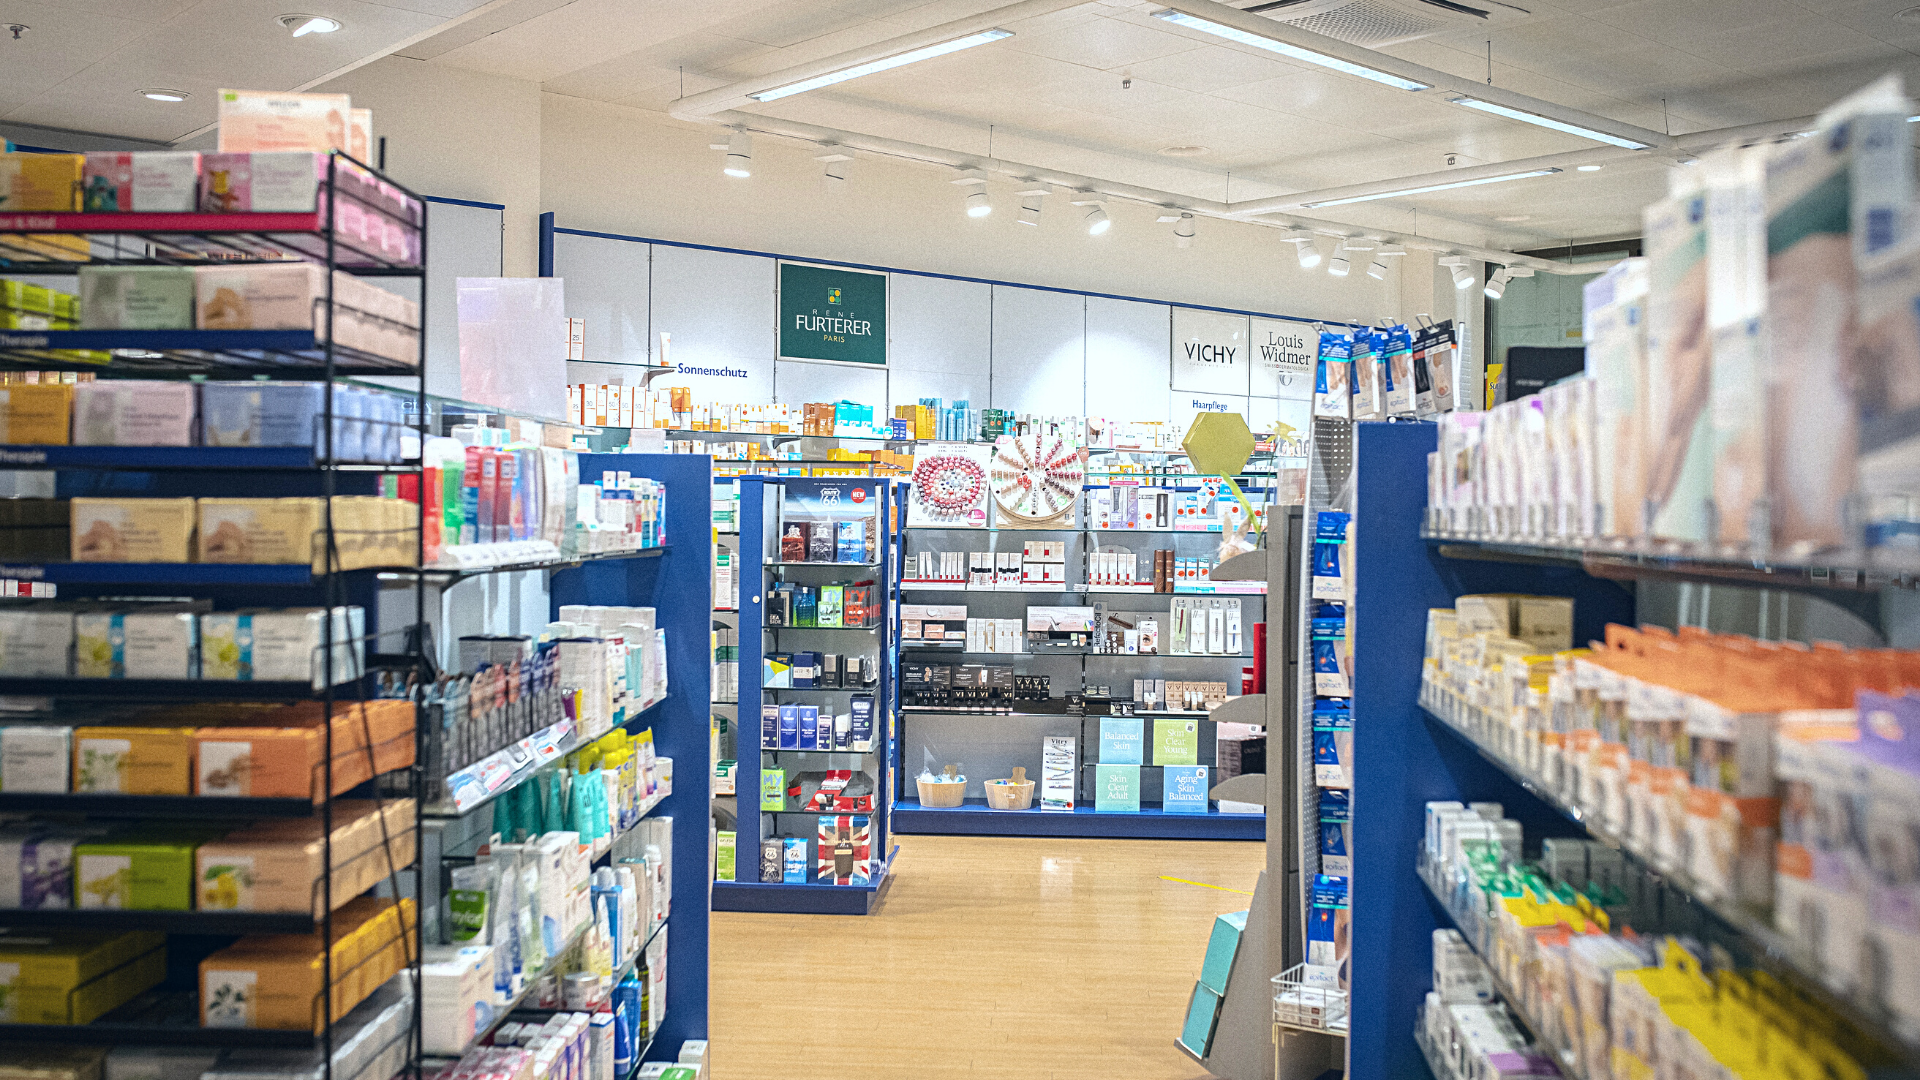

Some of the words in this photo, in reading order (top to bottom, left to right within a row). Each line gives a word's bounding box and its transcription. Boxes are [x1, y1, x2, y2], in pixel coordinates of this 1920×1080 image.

[812, 309, 854, 318] RENE
[796, 315, 871, 336] FURTERER
[823, 334, 845, 343] PARIS
[1268, 332, 1303, 349] Louis
[1184, 342, 1236, 364] VICHY
[1260, 345, 1311, 365] Widmer
[677, 362, 748, 378] Sonnenschutz
[1192, 399, 1228, 412] Haarpflege
[823, 496, 838, 506] 66
[1104, 732, 1139, 740] Balanced
[1167, 729, 1185, 737] Skin
[1113, 741, 1130, 750] Skin
[1165, 737, 1186, 746] Clear
[1163, 746, 1188, 755] Young
[763, 774, 783, 787] MY
[1109, 775, 1127, 783] Skin
[1174, 775, 1198, 784] Aging
[1107, 783, 1129, 791] Clear
[1177, 784, 1195, 793] Skin
[1107, 791, 1129, 800] Adult
[1168, 792, 1204, 800] Balanced
